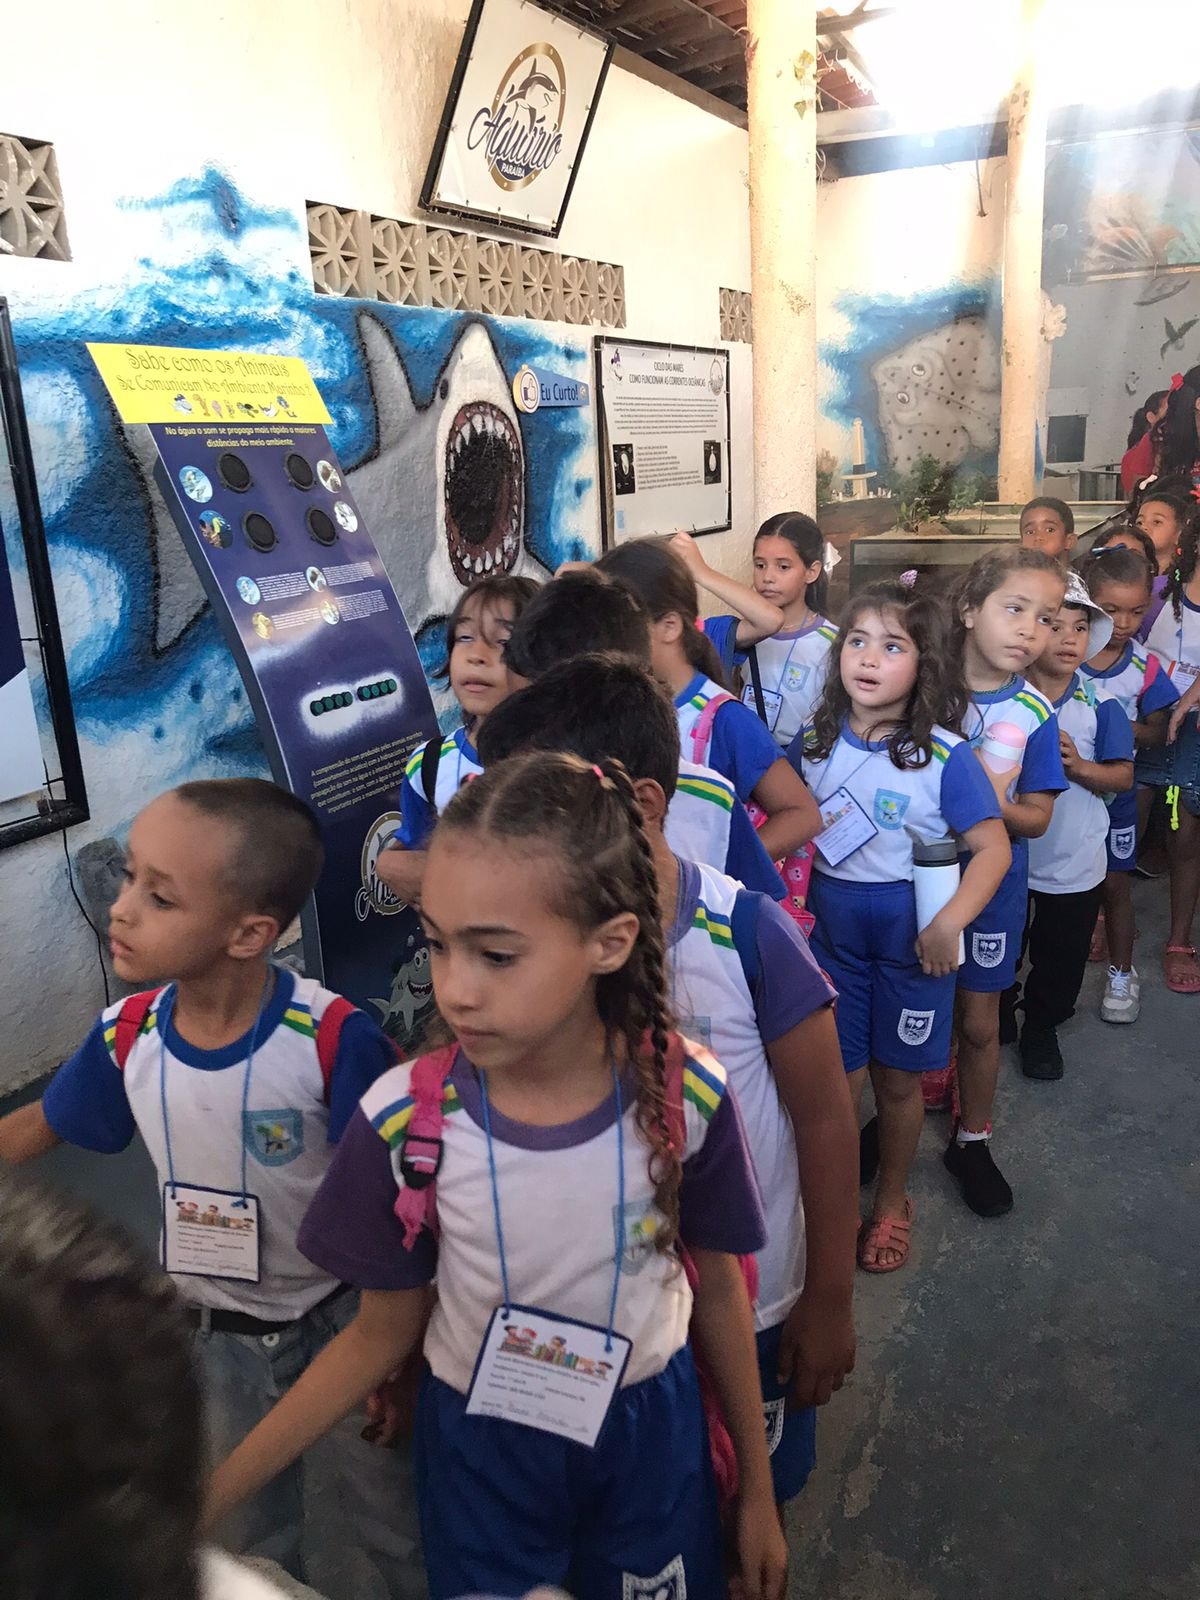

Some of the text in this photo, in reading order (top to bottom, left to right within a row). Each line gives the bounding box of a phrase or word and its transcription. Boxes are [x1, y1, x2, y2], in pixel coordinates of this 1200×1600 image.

[467, 84, 563, 172] Aquário
[125, 349, 290, 377] Sabe como os Animais
[135, 374, 203, 391] Comunicam
[221, 379, 268, 394] Ambiente
[267, 381, 305, 396] Marinho
[629, 374, 641, 384] COMO
[642, 374, 663, 385] FUNCIONAM
[541, 384, 578, 401] Eu Curto!
[165, 427, 177, 435] Na
[177, 426, 196, 436] água
[227, 427, 253, 436] propaga
